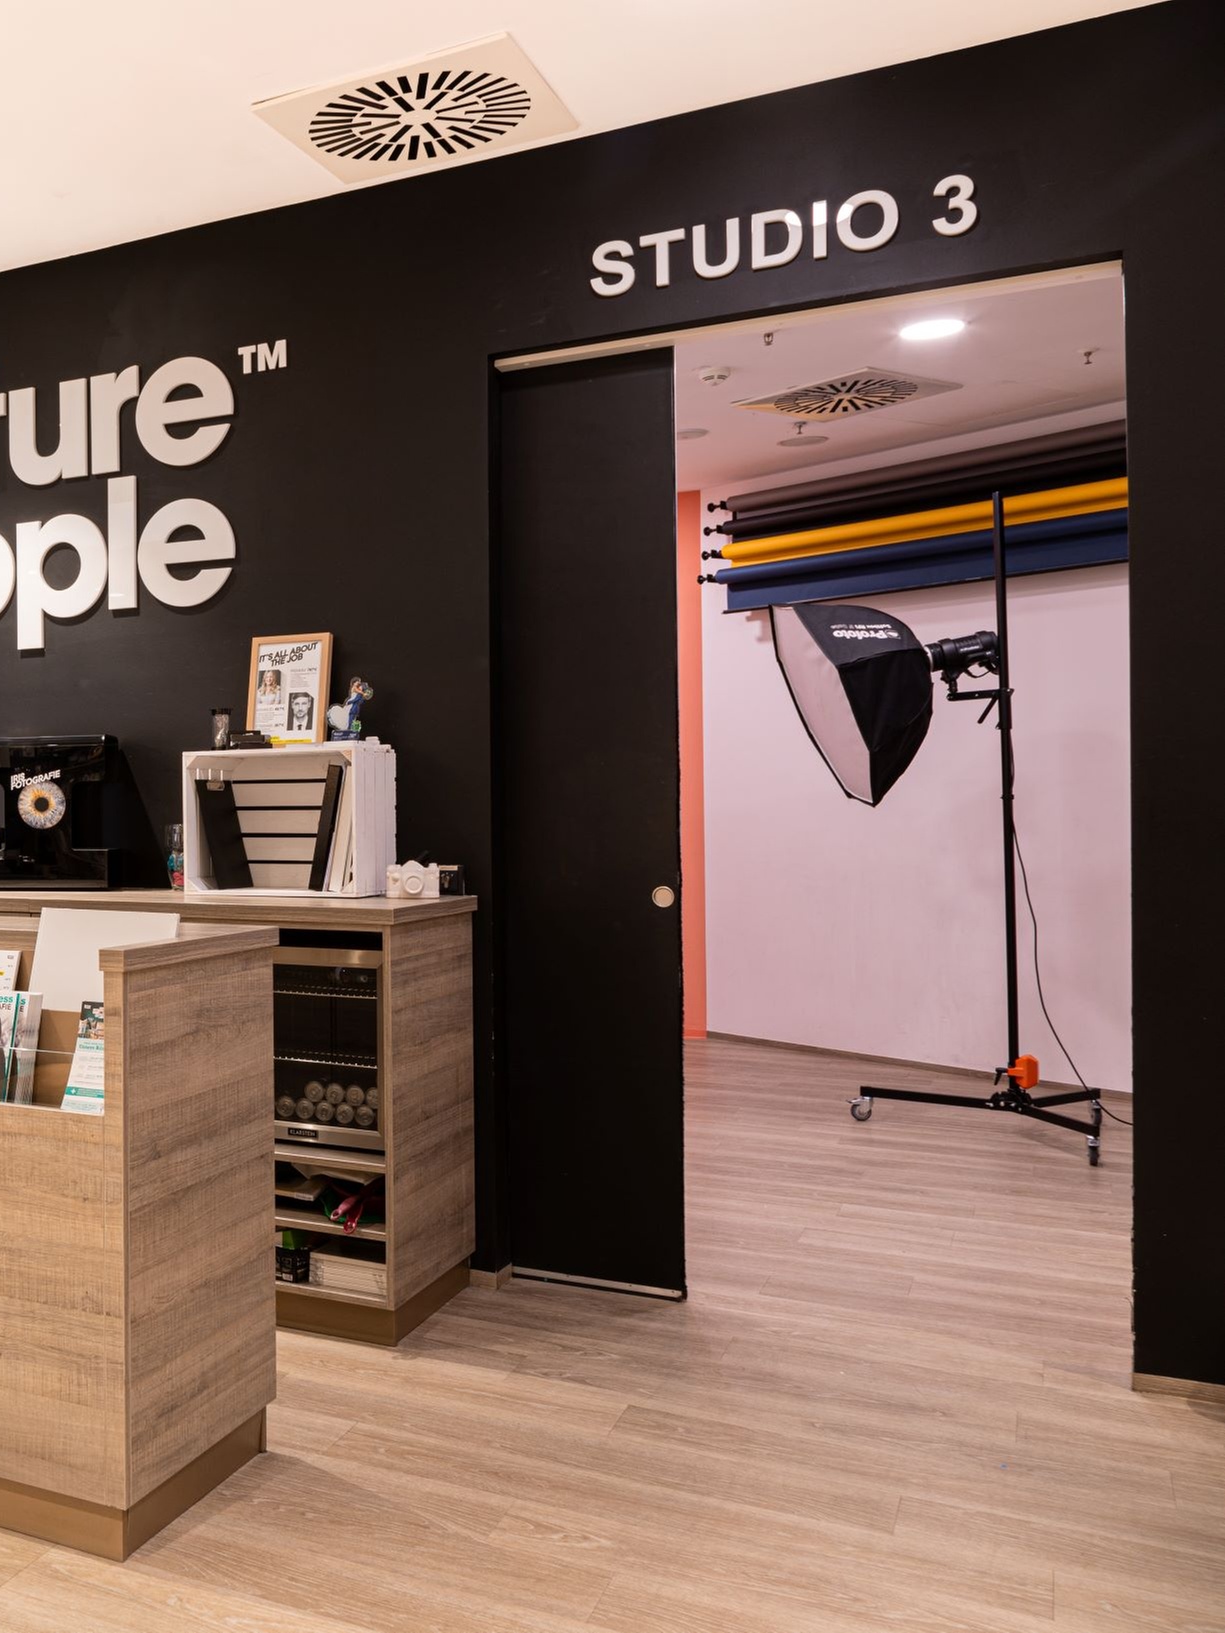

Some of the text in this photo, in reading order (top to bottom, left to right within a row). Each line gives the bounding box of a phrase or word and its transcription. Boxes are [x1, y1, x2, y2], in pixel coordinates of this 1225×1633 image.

[590, 174, 977, 298] STUDIO 3
[238, 338, 288, 375] TM
[832, 629, 889, 640] Profoto
[274, 649, 288, 659] ALL
[290, 641, 319, 655] ABOUT
[271, 652, 304, 667] THE JOB
[10, 772, 26, 783] IRIS
[10, 769, 61, 791] FOTOGRAFIE
